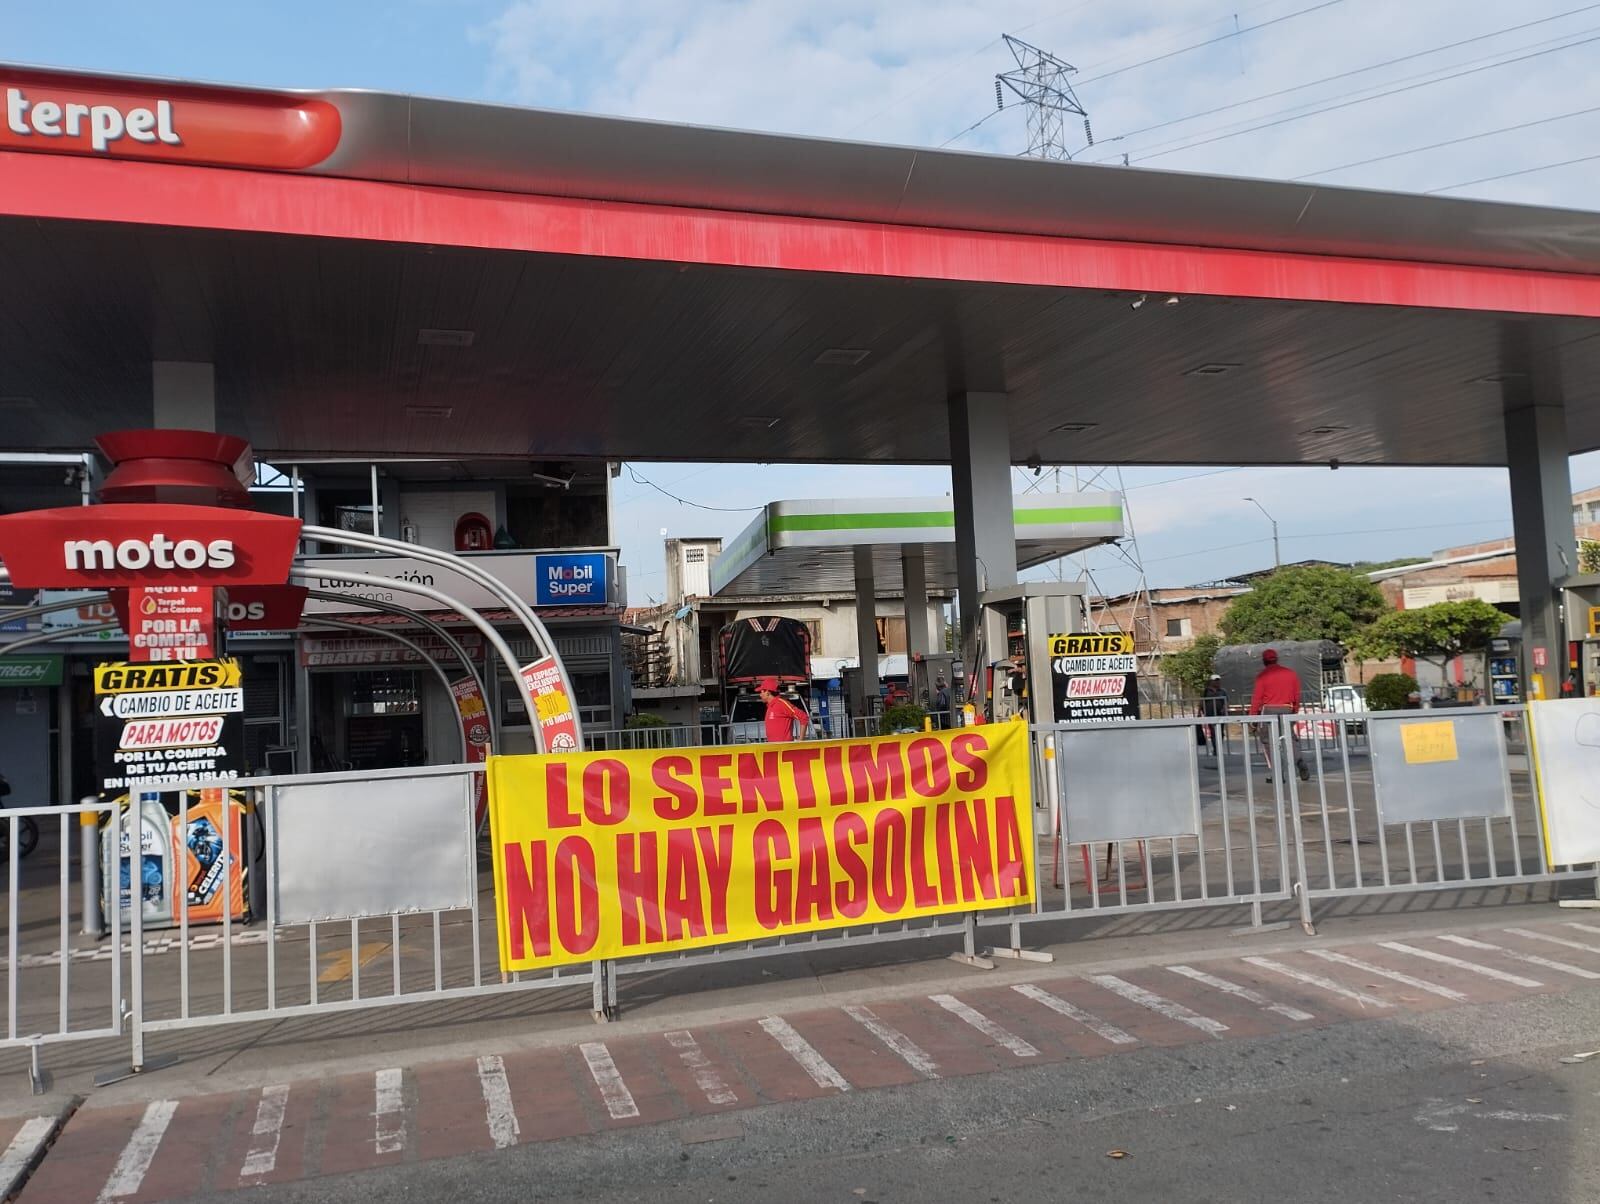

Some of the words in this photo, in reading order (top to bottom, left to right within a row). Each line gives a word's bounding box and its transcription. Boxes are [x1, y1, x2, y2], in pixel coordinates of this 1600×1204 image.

[7, 88, 181, 151] terpel
[64, 534, 235, 570] motos
[549, 565, 593, 580] Mobil
[549, 581, 593, 596] Super
[157, 598, 186, 608] Terpel
[141, 619, 178, 633] POR
[180, 618, 201, 633] LA
[134, 632, 209, 648] COMPRA
[1053, 636, 1123, 655] GRATIS
[149, 647, 172, 661] DE
[174, 646, 198, 660] TU
[307, 651, 377, 665] GRATIS
[1065, 658, 1095, 673] CAMBIO
[1096, 657, 1107, 671] DE
[1108, 656, 1134, 671] ACEITE
[101, 665, 220, 690] GRATIS
[527, 674, 561, 691] EXCLUSIVO
[537, 684, 555, 696] PARA
[1070, 678, 1092, 696] PARA
[1092, 677, 1124, 695] MOTOS
[119, 695, 171, 714] CAMBIO
[175, 694, 191, 711] DE
[195, 692, 238, 711] ACEITE
[1063, 700, 1081, 709] POR
[1081, 699, 1092, 707] LA
[1092, 697, 1129, 707] COMPRA
[1071, 709, 1083, 717] DE
[1083, 708, 1094, 716] TU
[1094, 706, 1123, 716] ACEITE
[124, 723, 167, 746] PARA
[166, 720, 219, 743] MOTOS
[113, 751, 144, 763] POR
[144, 750, 164, 761] LA
[164, 746, 227, 760] COMPRA
[126, 763, 145, 775] DE
[146, 762, 166, 773] TU
[166, 759, 216, 773] ACEITE
[103, 777, 124, 789] EN
[124, 772, 198, 786] NUESTRAS
[199, 769, 239, 782] ISLAS
[545, 757, 631, 829] LO
[650, 732, 990, 821] SENTIMOS
[199, 850, 226, 894] CELERIT
[504, 834, 600, 960] NO
[616, 823, 735, 947] HAY
[752, 795, 1028, 931] GASOLINA
